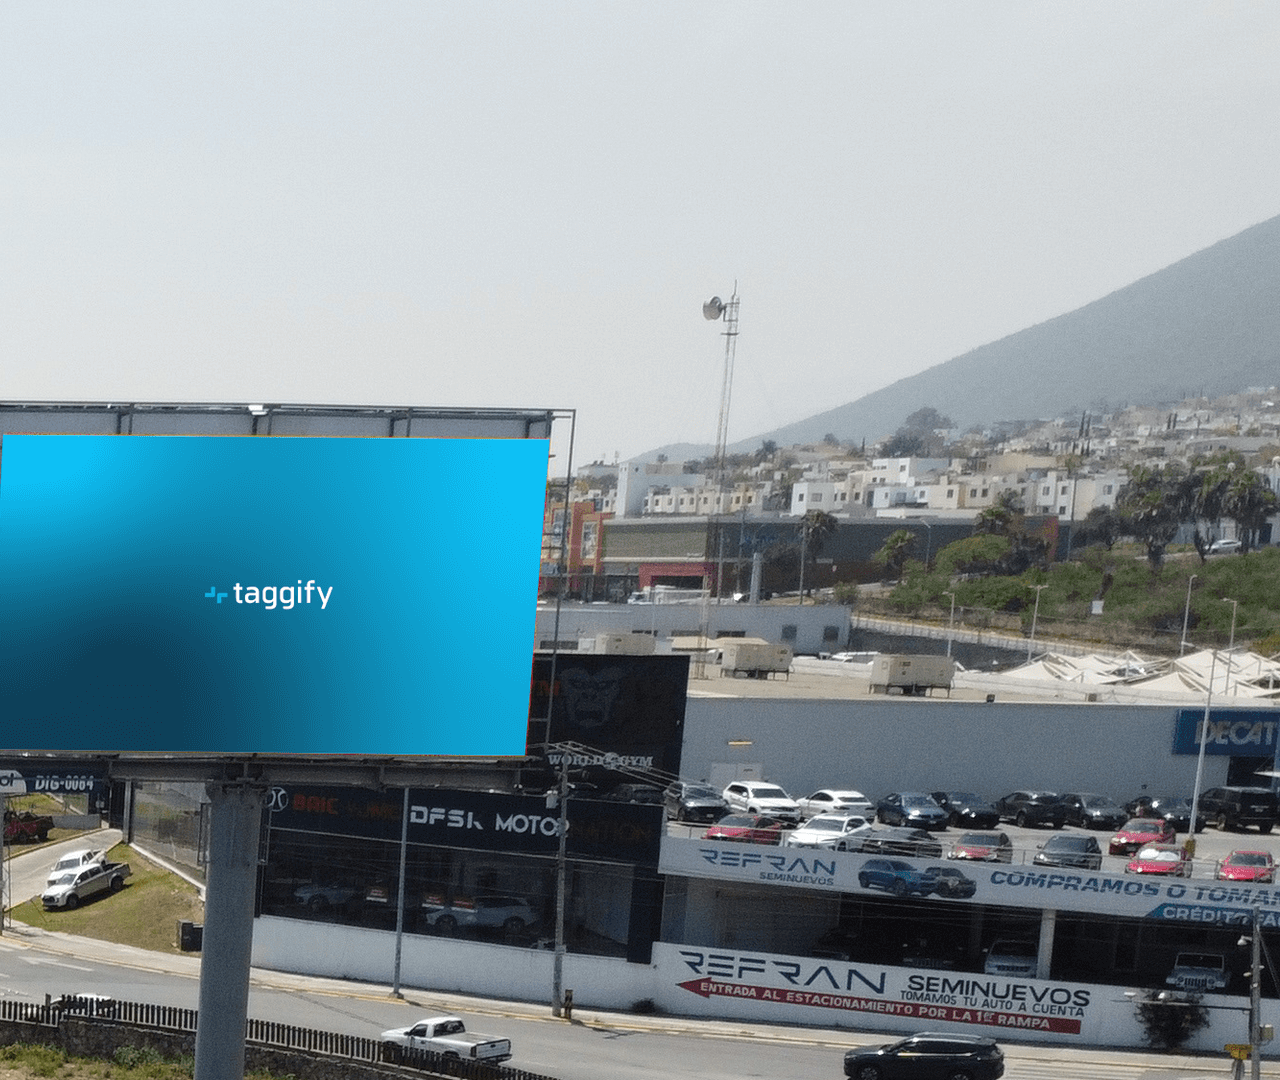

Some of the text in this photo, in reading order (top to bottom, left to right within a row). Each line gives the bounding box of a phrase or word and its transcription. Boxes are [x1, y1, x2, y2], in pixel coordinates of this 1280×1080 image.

[233, 579, 333, 609] taggify
[620, 755, 653, 767] GYM
[698, 848, 836, 876] REFRAN
[759, 871, 834, 886] SEMINUEVOS
[990, 870, 1160, 897] COMPRAMOS
[1166, 883, 1187, 899] O
[679, 950, 886, 994] REFRAN
[900, 990, 1085, 1018] TOMAMOS TU AUTO A CUENTA
[908, 974, 1090, 1008] SEMINUEVOS
[700, 982, 757, 998] ENTRADA
[762, 989, 781, 1001] AL
[786, 991, 914, 1016] ESTACIONAMIENTO
[918, 1005, 947, 1019] POR
[952, 1010, 972, 1022] LA
[998, 1014, 1050, 1030] RAMPA
